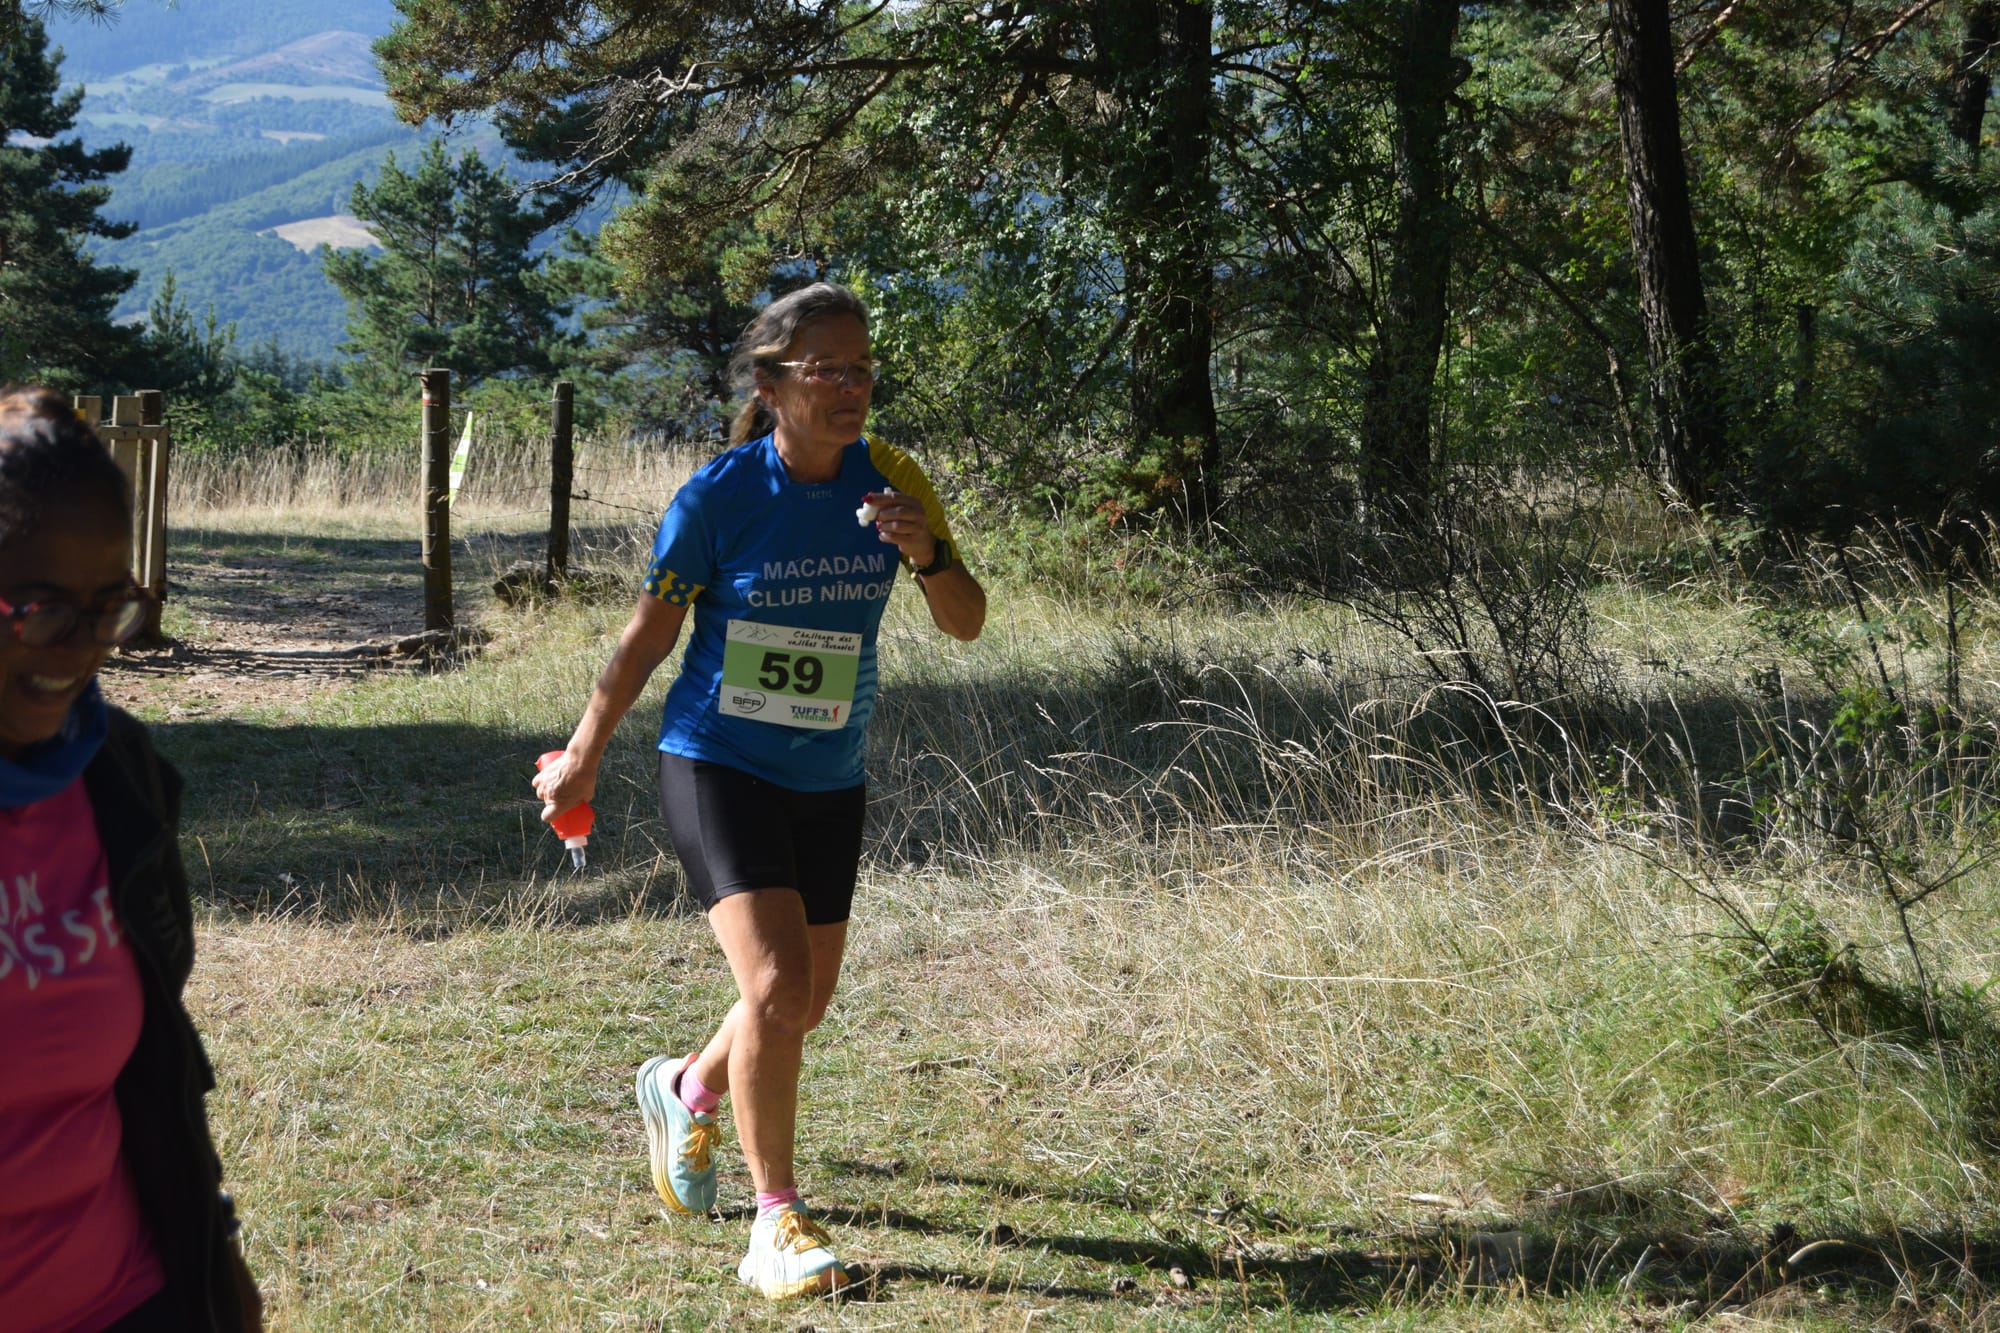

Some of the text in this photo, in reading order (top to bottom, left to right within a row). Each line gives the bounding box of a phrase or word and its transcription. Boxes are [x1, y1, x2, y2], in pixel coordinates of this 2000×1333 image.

[763, 553, 886, 581] MACADAM
[747, 580, 892, 608] CLUB NÎMOIS
[758, 651, 824, 695] 59
[732, 696, 761, 707] BFP
[790, 704, 829, 716] TUFF'S
